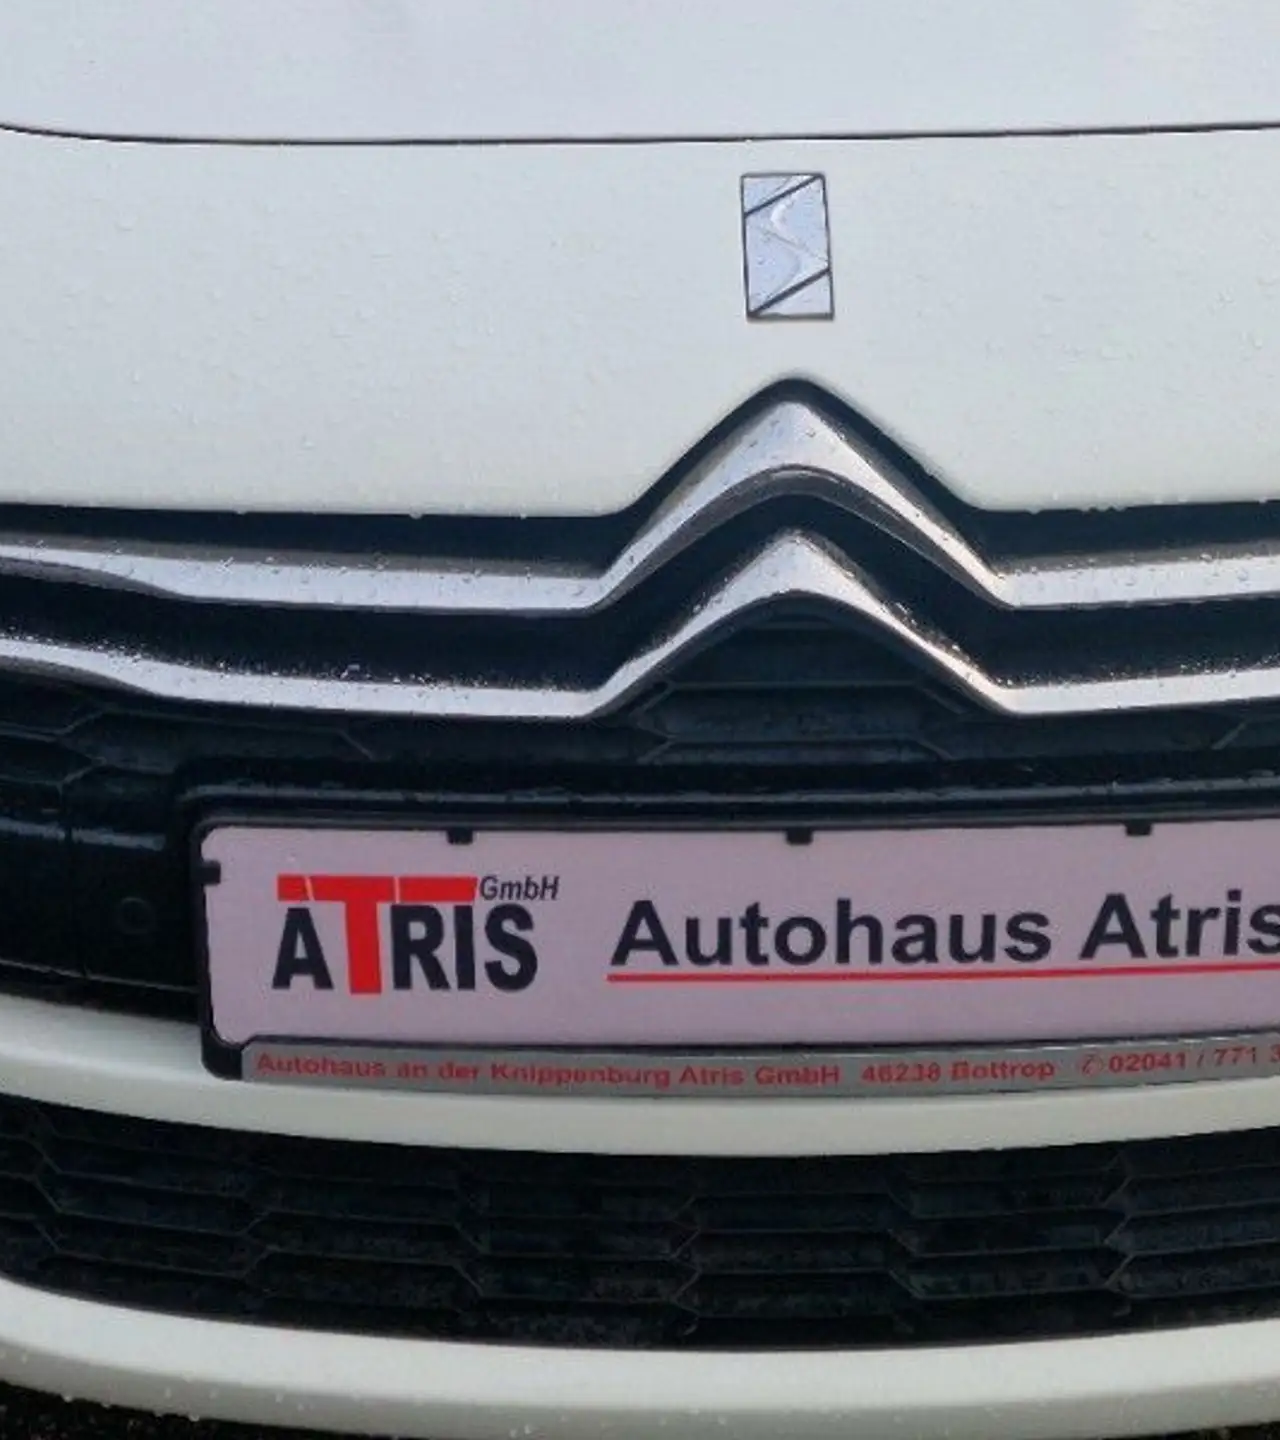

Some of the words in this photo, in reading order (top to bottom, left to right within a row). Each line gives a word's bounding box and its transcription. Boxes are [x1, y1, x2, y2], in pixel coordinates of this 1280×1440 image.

[478, 875, 560, 902] GmbH
[272, 874, 538, 995] ATRIS
[610, 897, 1053, 967] Autohaus
[256, 1051, 385, 1079] Autohaus
[397, 1062, 428, 1078] an
[438, 1061, 479, 1080] der
[490, 1063, 671, 1089] Knippenburg
[678, 1065, 745, 1086] Atris
[754, 1065, 841, 1086] GmbH
[950, 1060, 1055, 1083] Bottrop
[1108, 1051, 1188, 1074] 02041
[1213, 1046, 1257, 1068] 771
